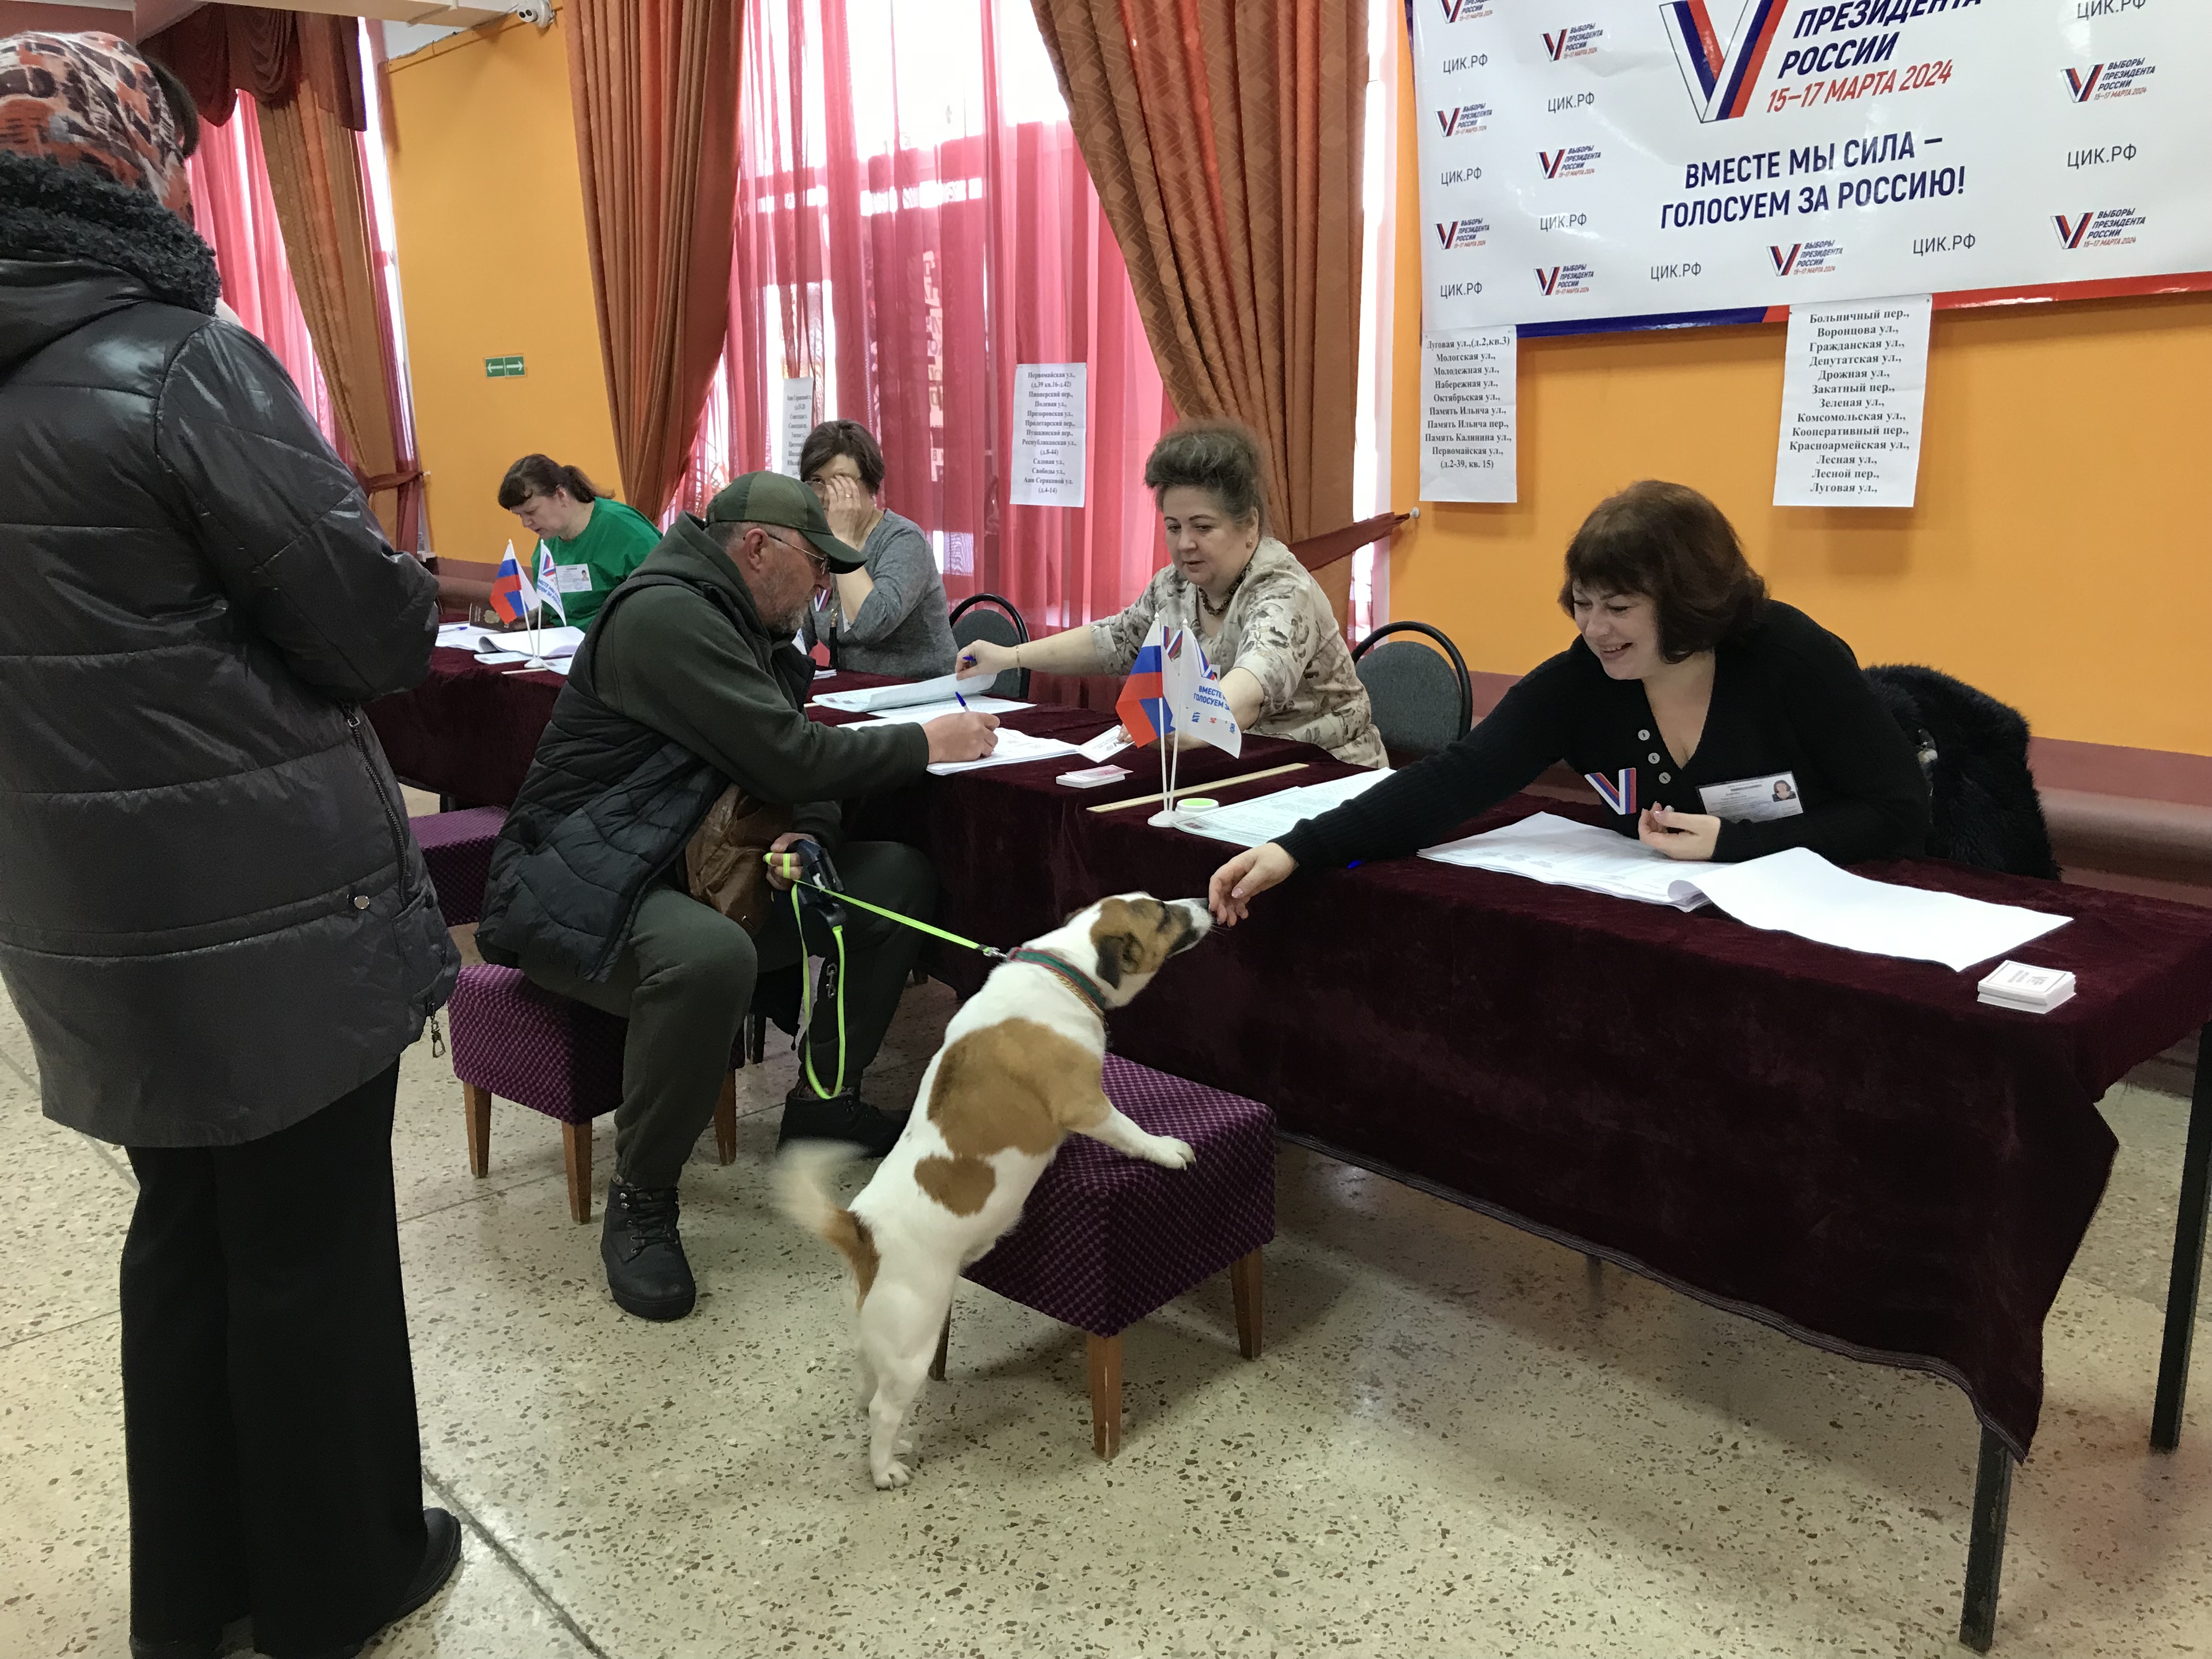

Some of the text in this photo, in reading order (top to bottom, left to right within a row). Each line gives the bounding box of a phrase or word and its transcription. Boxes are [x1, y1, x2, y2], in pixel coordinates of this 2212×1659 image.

[1793, 0, 1982, 39] ПРЕЗИДЕ
[1778, 31, 1900, 79] РОССИИ
[1443, 53, 1488, 74] ЦИК.РФ
[2107, 58, 2145, 70] ВЫБОРЫ
[2102, 65, 2155, 81] ПРЕЗИДЕНТА
[1824, 69, 1898, 104] МАРТА
[1898, 59, 1953, 92] 2024
[2097, 79, 2132, 91] РОССИИ
[1548, 92, 1594, 114] ЦИК.РФ
[1567, 145, 1594, 154] ВЫБОРЫ
[1565, 152, 1601, 162] ПРЕЗИДЕНТА
[1685, 151, 1780, 189] ВМЕСТЕ
[1789, 143, 1835, 175] МЫ
[1844, 131, 1915, 167] СИЛА
[2067, 144, 2136, 170] ЦИК.РФ
[1561, 162, 1585, 171] РОССИИ
[1441, 167, 1482, 187] ЦИК.РФ
[1661, 166, 1965, 229] ГОЛОСУЕМ ЗА РОССИЮ!
[2097, 208, 2135, 219] ВЫБОРЫ
[1461, 218, 1483, 226] ВЫБОРЫ
[1541, 212, 1587, 232] ЦИК.РФ
[2092, 217, 2146, 229] ПРЕЗИДЕНТА
[1458, 224, 1489, 234] ПРЕЗИДЕНТА
[2087, 229, 2122, 239] РОССИИ
[1455, 234, 1477, 242] РОССИИ
[1804, 240, 1835, 250] ВЫБОРЫ
[1913, 233, 1976, 256] ЦИК.РФ
[1800, 247, 1843, 258] ПРЕЗИДЕНТА
[1562, 264, 1587, 272] ВЫБОРЫ
[1796, 258, 1824, 267] РОССИИ
[1560, 271, 1594, 280] ПРЕЗИДЕНТА
[1651, 262, 1701, 282] ЦИК.РФ
[1441, 281, 1482, 299] ЦИК.РФ
[1810, 309, 1910, 324] Больничный пер.,
[1817, 325, 1899, 338] Воронцова ул.,
[1427, 341, 1454, 351] Луговая
[1809, 340, 1905, 353] Гражданская ул.,
[1436, 353, 1496, 362] Мологская ул.,
[1809, 354, 1901, 368] Депутатская ул.,
[1434, 366, 1499, 376] Молодежная ул.,
[1818, 369, 1890, 382] Дрожная ул.,
[1435, 380, 1498, 390] Набережная ул.,
[1812, 383, 1895, 394] Закатный пер.,
[1434, 394, 1500, 403] Октябрьская ул.,
[1819, 398, 1884, 408] Зеленая ул.,
[1429, 407, 1506, 416] Память Ильича ул.,
[1797, 413, 1906, 422] Комсомольская ул.,
[1427, 420, 1509, 429] Память Ильича пер.,
[1792, 426, 1909, 438] Кооперативный пер.,
[1425, 433, 1511, 443] Память Калинина ул.,
[1432, 447, 1504, 456] Первомайская ул.,
[1789, 440, 1910, 453] Красноармейская ул.,
[1816, 455, 1877, 466] Лесная ул.,
[1812, 469, 1880, 480] Лесной пер.,
[1810, 483, 1877, 494] Луговая ул.,
[1198, 685, 1222, 698] ВМЕСТЕ
[1193, 693, 1224, 708] ГОЛОСУЕМ
